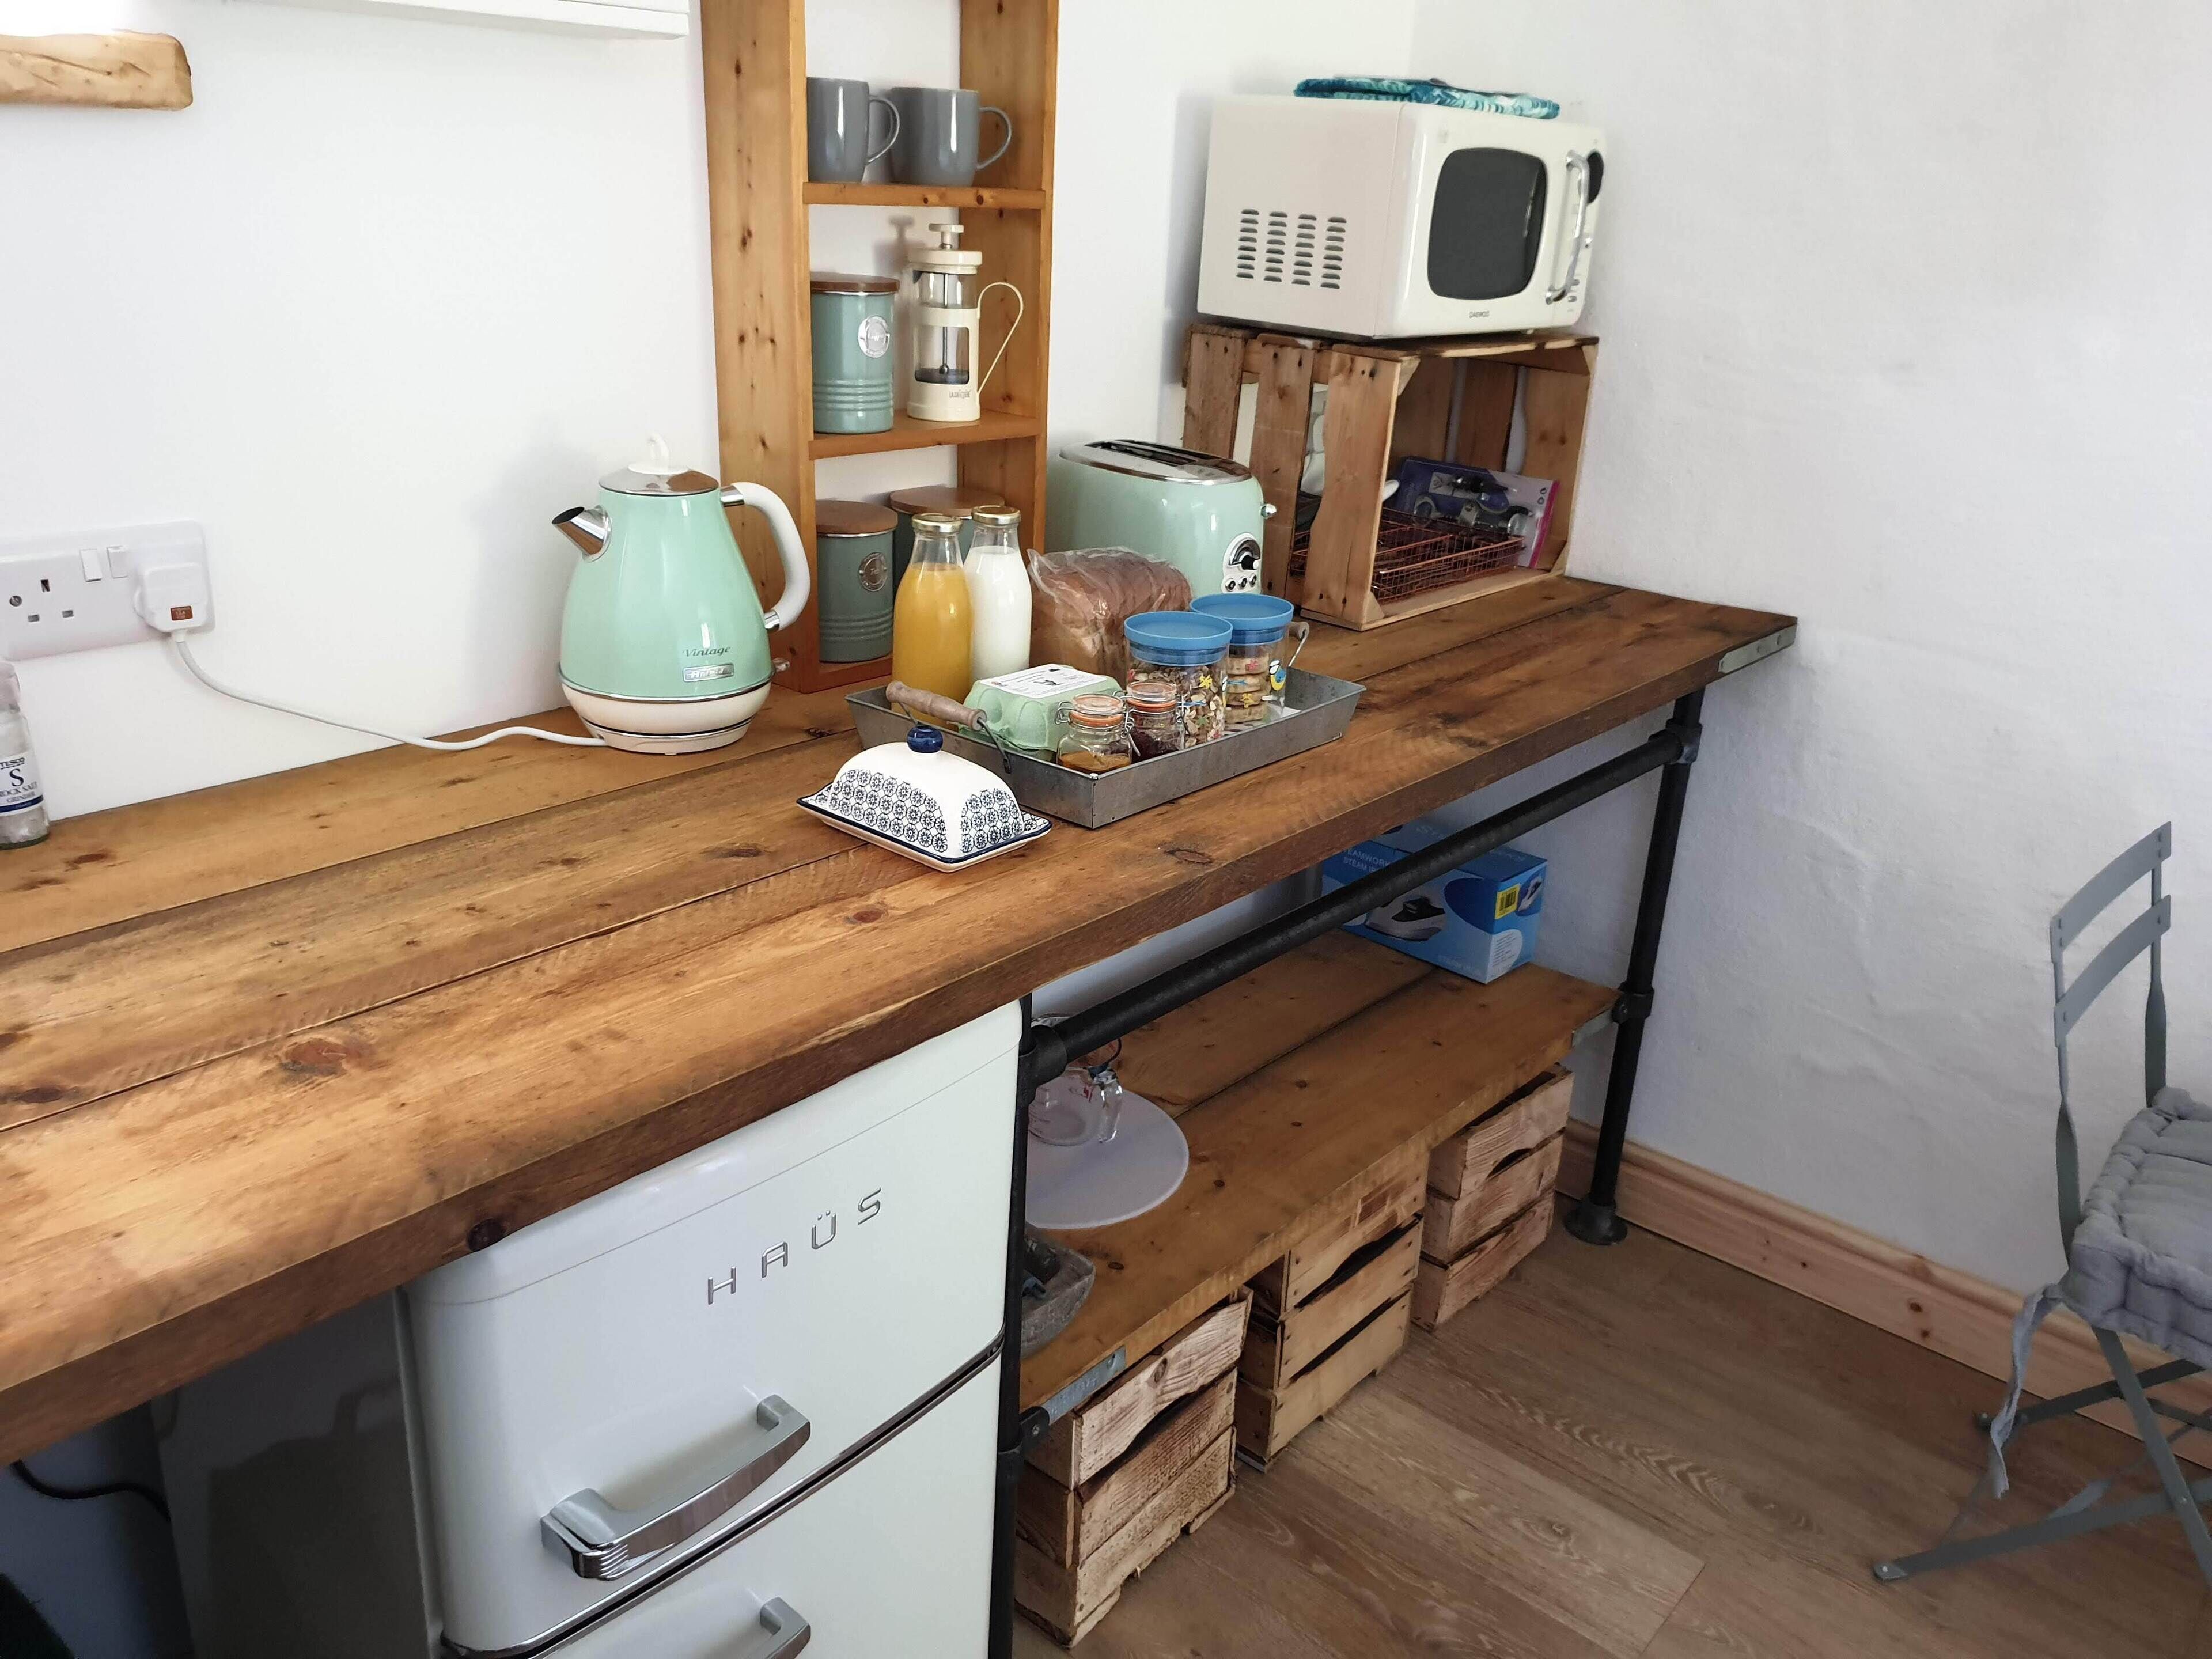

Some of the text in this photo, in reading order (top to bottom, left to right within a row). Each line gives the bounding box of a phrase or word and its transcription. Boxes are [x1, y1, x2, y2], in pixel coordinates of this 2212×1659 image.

[683, 646, 731, 657] Vintage
[0, 757, 25, 767] TESCO
[9, 768, 24, 787] S
[708, 1187, 881, 1305] HAÜS
